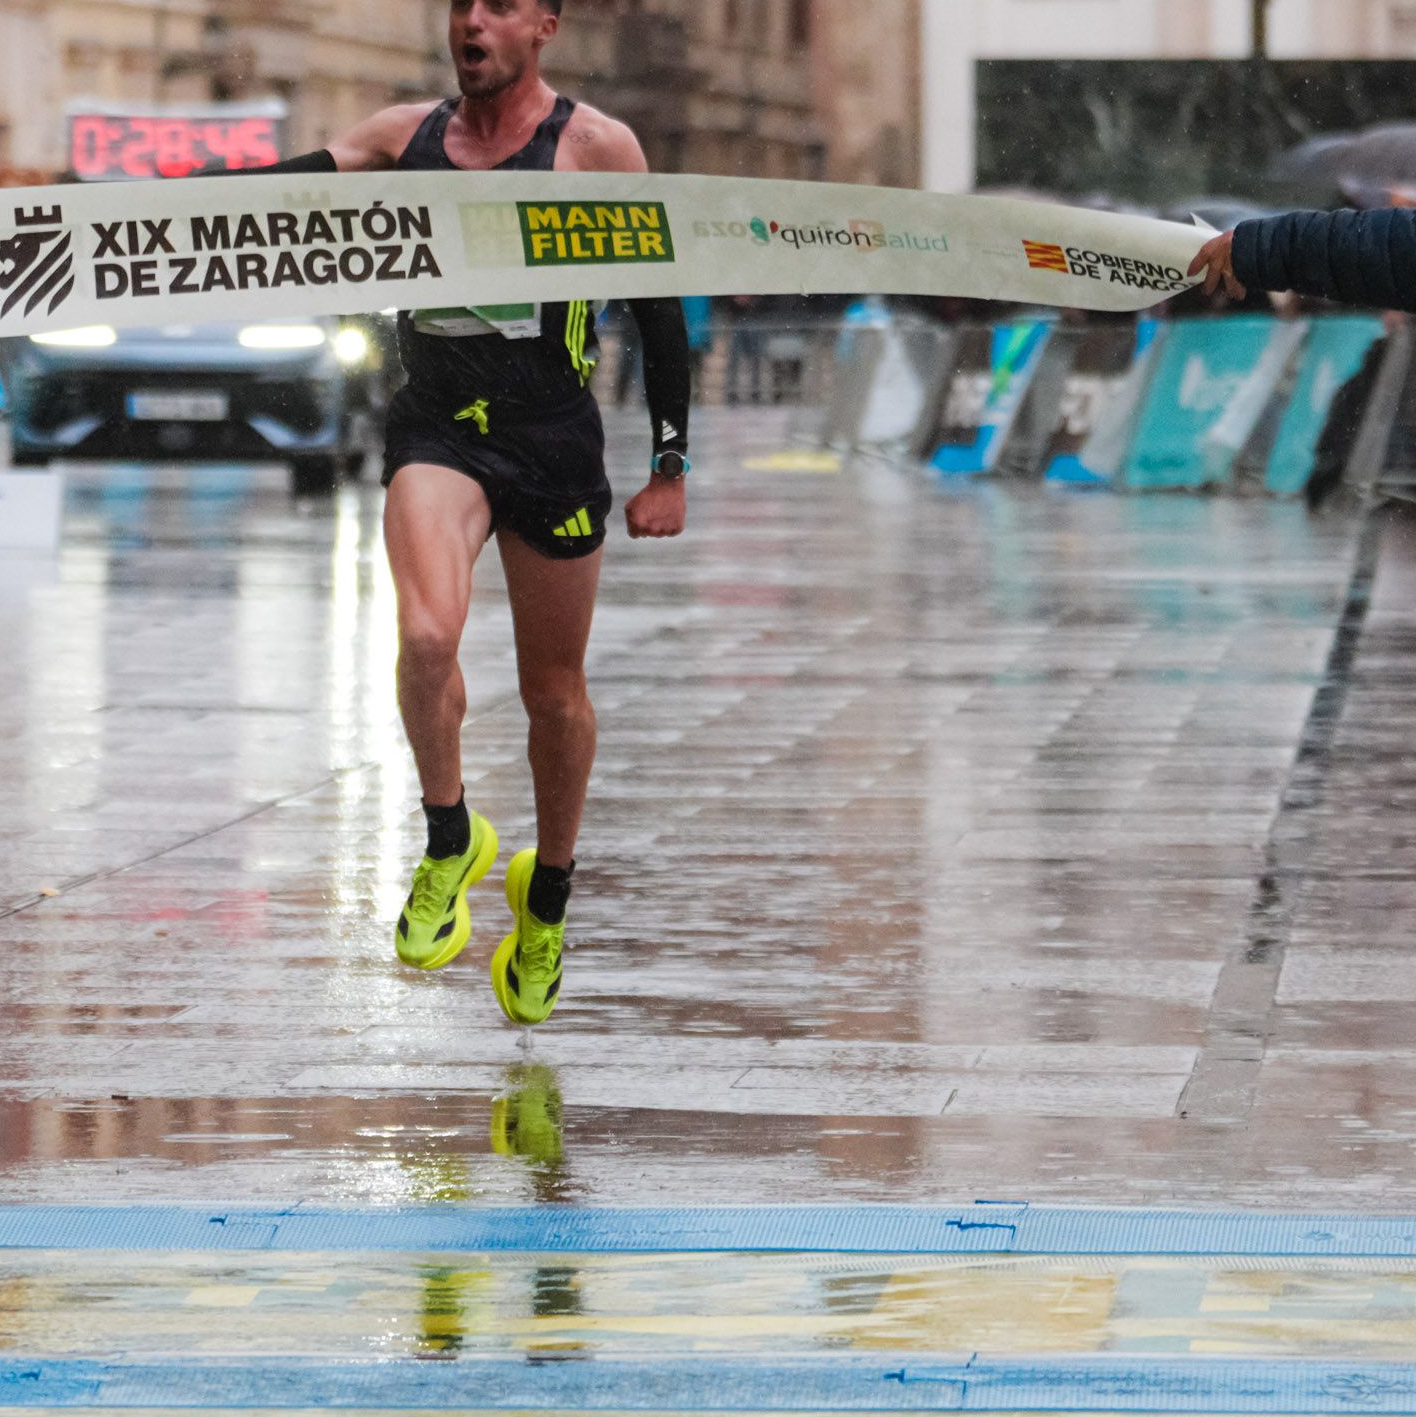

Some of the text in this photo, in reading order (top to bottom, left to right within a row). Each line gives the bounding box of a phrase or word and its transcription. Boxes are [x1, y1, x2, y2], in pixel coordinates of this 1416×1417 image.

[91, 200, 433, 259] XIX MARATÓN
[525, 205, 660, 231] MANN
[531, 228, 666, 260] FILTER
[94, 244, 443, 300] DE ZARAGOZA
[1066, 247, 1183, 281] GOBIERNO
[1069, 261, 1102, 280] DE
